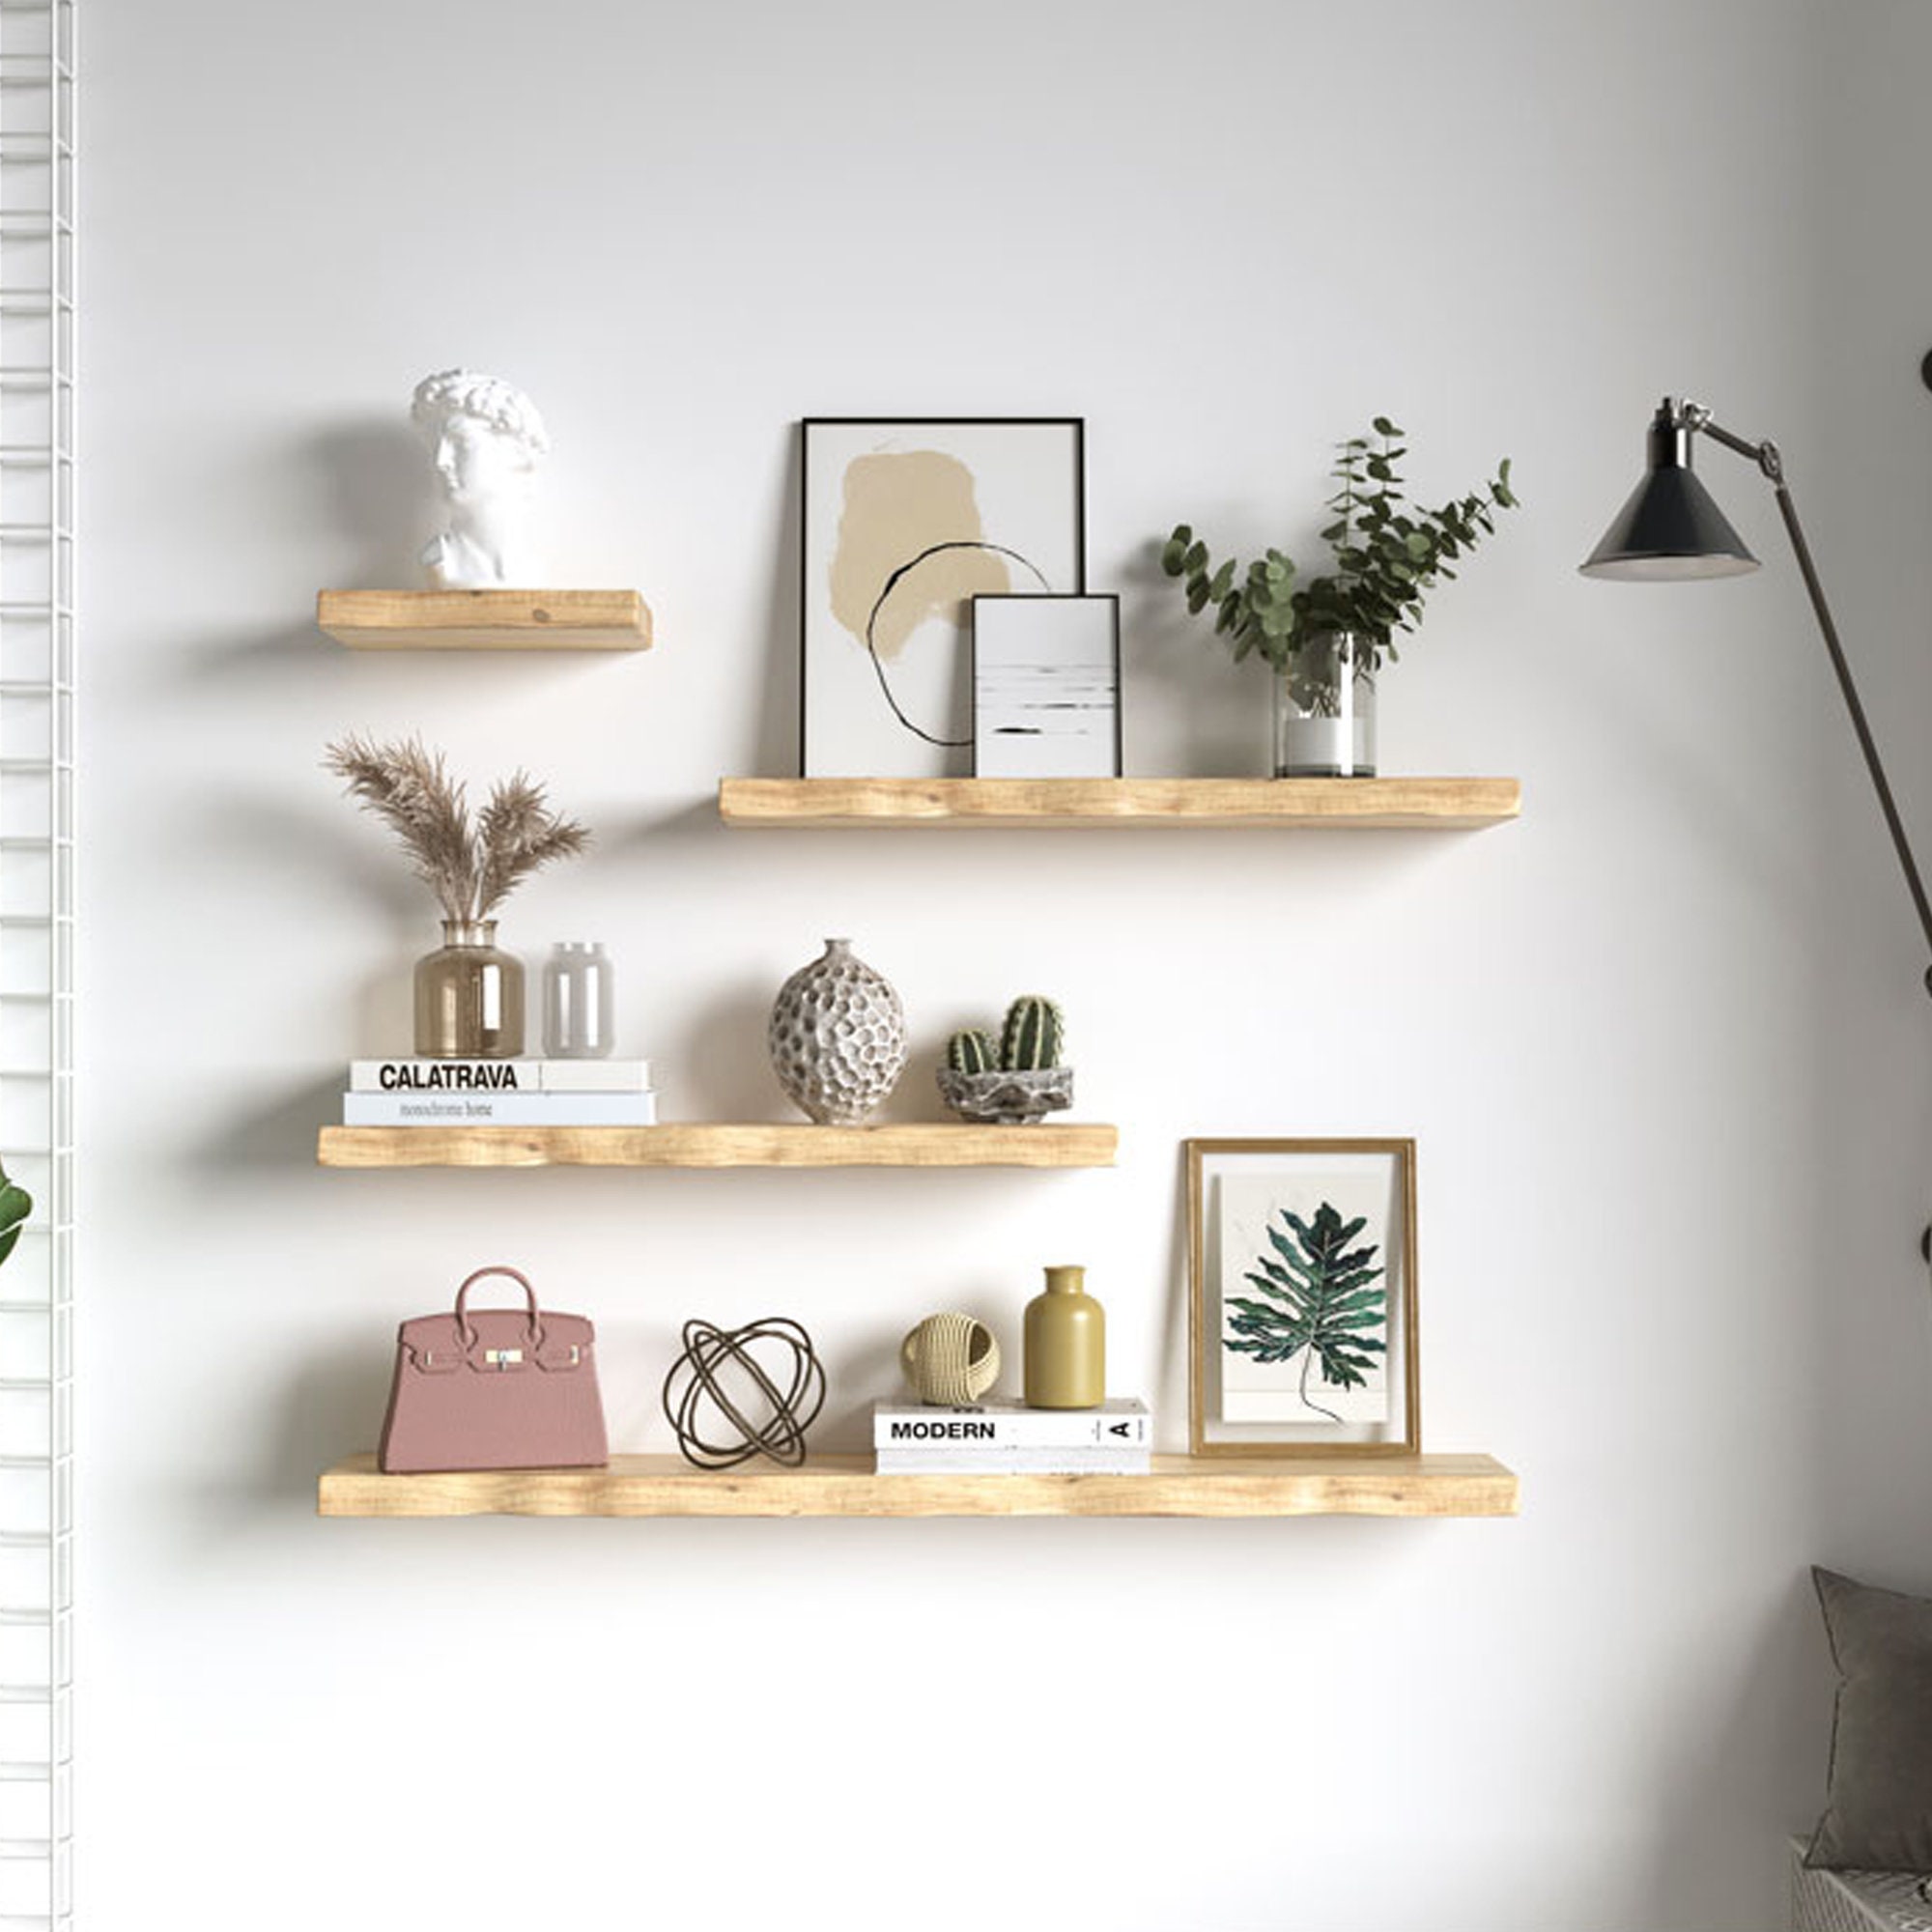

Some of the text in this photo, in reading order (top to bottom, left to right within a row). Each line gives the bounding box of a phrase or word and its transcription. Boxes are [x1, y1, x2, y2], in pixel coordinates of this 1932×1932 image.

[379, 1064, 518, 1089] CALATRAVA
[891, 1422, 995, 1440] MODERN
[1109, 1422, 1130, 1438] A
